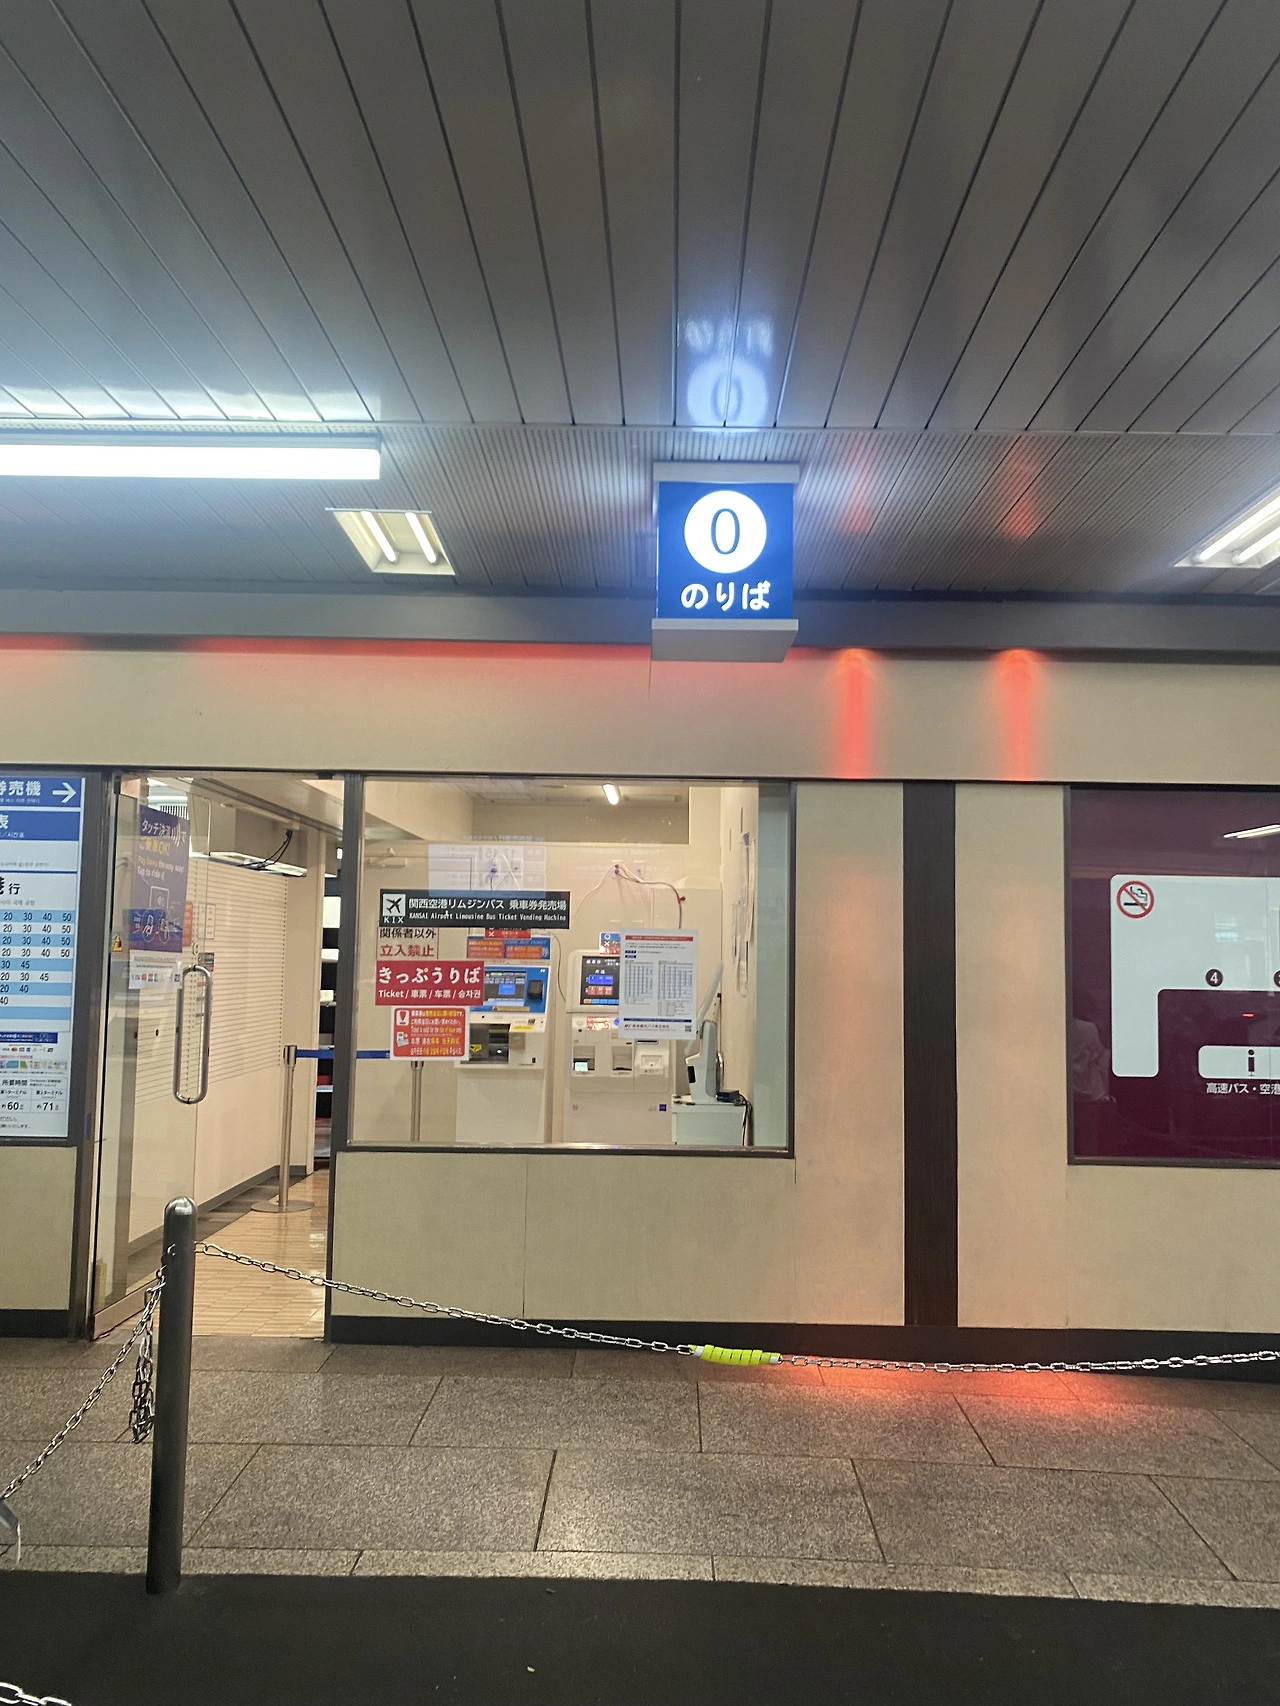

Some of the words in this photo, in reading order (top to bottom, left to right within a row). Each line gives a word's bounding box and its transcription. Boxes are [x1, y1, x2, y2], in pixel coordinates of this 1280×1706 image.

[710, 508, 740, 555] 0
[681, 580, 771, 611] のりば
[408, 898, 504, 909] 関西空港リムジンバス
[509, 899, 567, 911] 乗車券発売場
[4, 912, 12, 920] 20
[43, 913, 52, 921] 40
[62, 913, 71, 921] 50
[383, 916, 404, 924] KIX
[520, 913, 542, 922] Vending
[3, 924, 12, 932] 20
[23, 924, 31, 932] 30
[42, 925, 51, 933] 40
[62, 925, 70, 933] 50
[379, 928, 436, 939] 関係者以外
[2, 936, 11, 944] 20
[42, 937, 50, 945] 40
[61, 937, 70, 945] 50
[2, 948, 10, 956] 20
[22, 949, 30, 957] 30
[41, 949, 50, 957] 40
[61, 949, 70, 957] 50
[380, 944, 434, 957] 立入禁止
[1, 960, 10, 968] 30
[21, 961, 30, 969] 45
[1, 972, 9, 980] 20
[20, 973, 29, 981] 30
[40, 973, 49, 981] 45
[378, 966, 481, 985] きっぷうりば
[1210, 972, 1218, 984] 4
[0, 984, 9, 992] 20
[19, 985, 28, 993] 40
[378, 990, 404, 998] Ticket
[410, 990, 427, 998] 車票
[434, 990, 451, 998] 车票
[458, 990, 481, 999] 승차권
[0, 997, 8, 1005] 40
